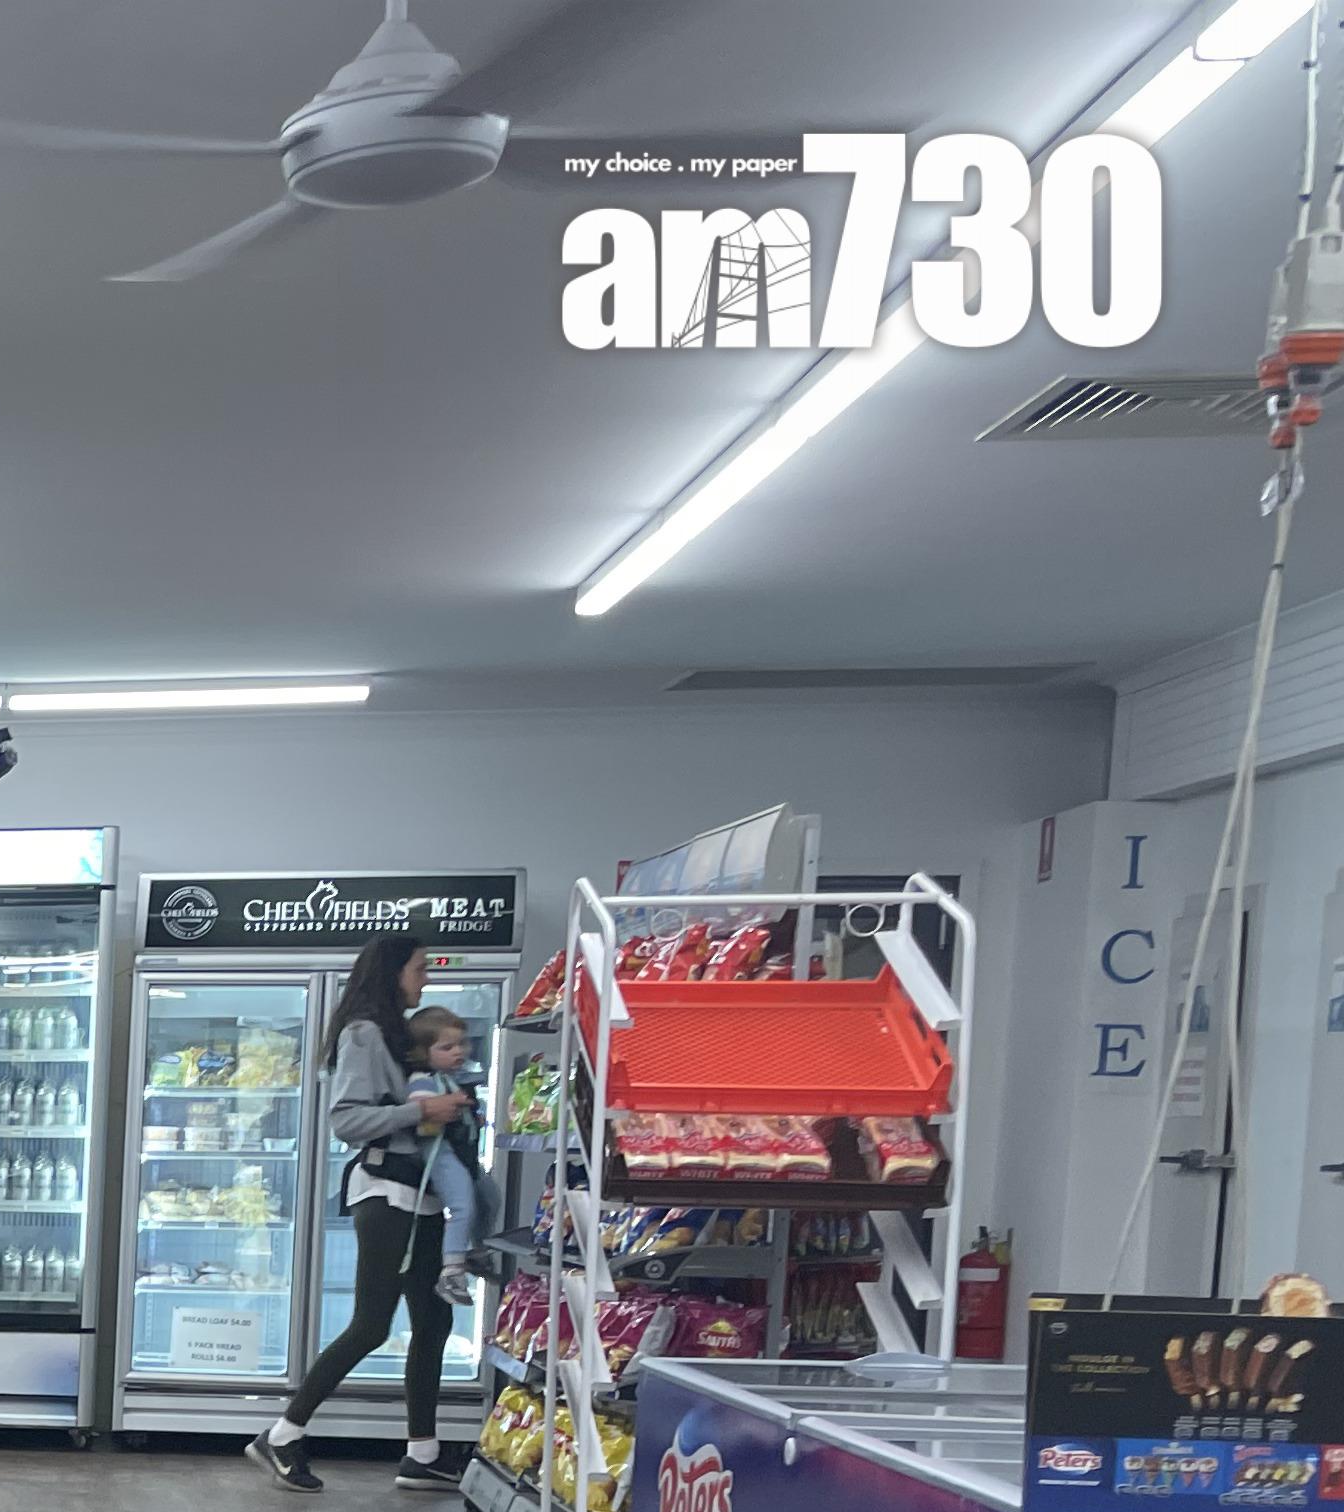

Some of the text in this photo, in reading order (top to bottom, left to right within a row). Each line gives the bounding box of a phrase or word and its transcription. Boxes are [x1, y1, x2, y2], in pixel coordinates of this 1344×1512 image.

[244, 899, 410, 922] CHEF FIELDS
[430, 897, 506, 919] MEAT
[440, 920, 494, 932] FRIDGE
[1038, 1449, 1103, 1471] Peters
